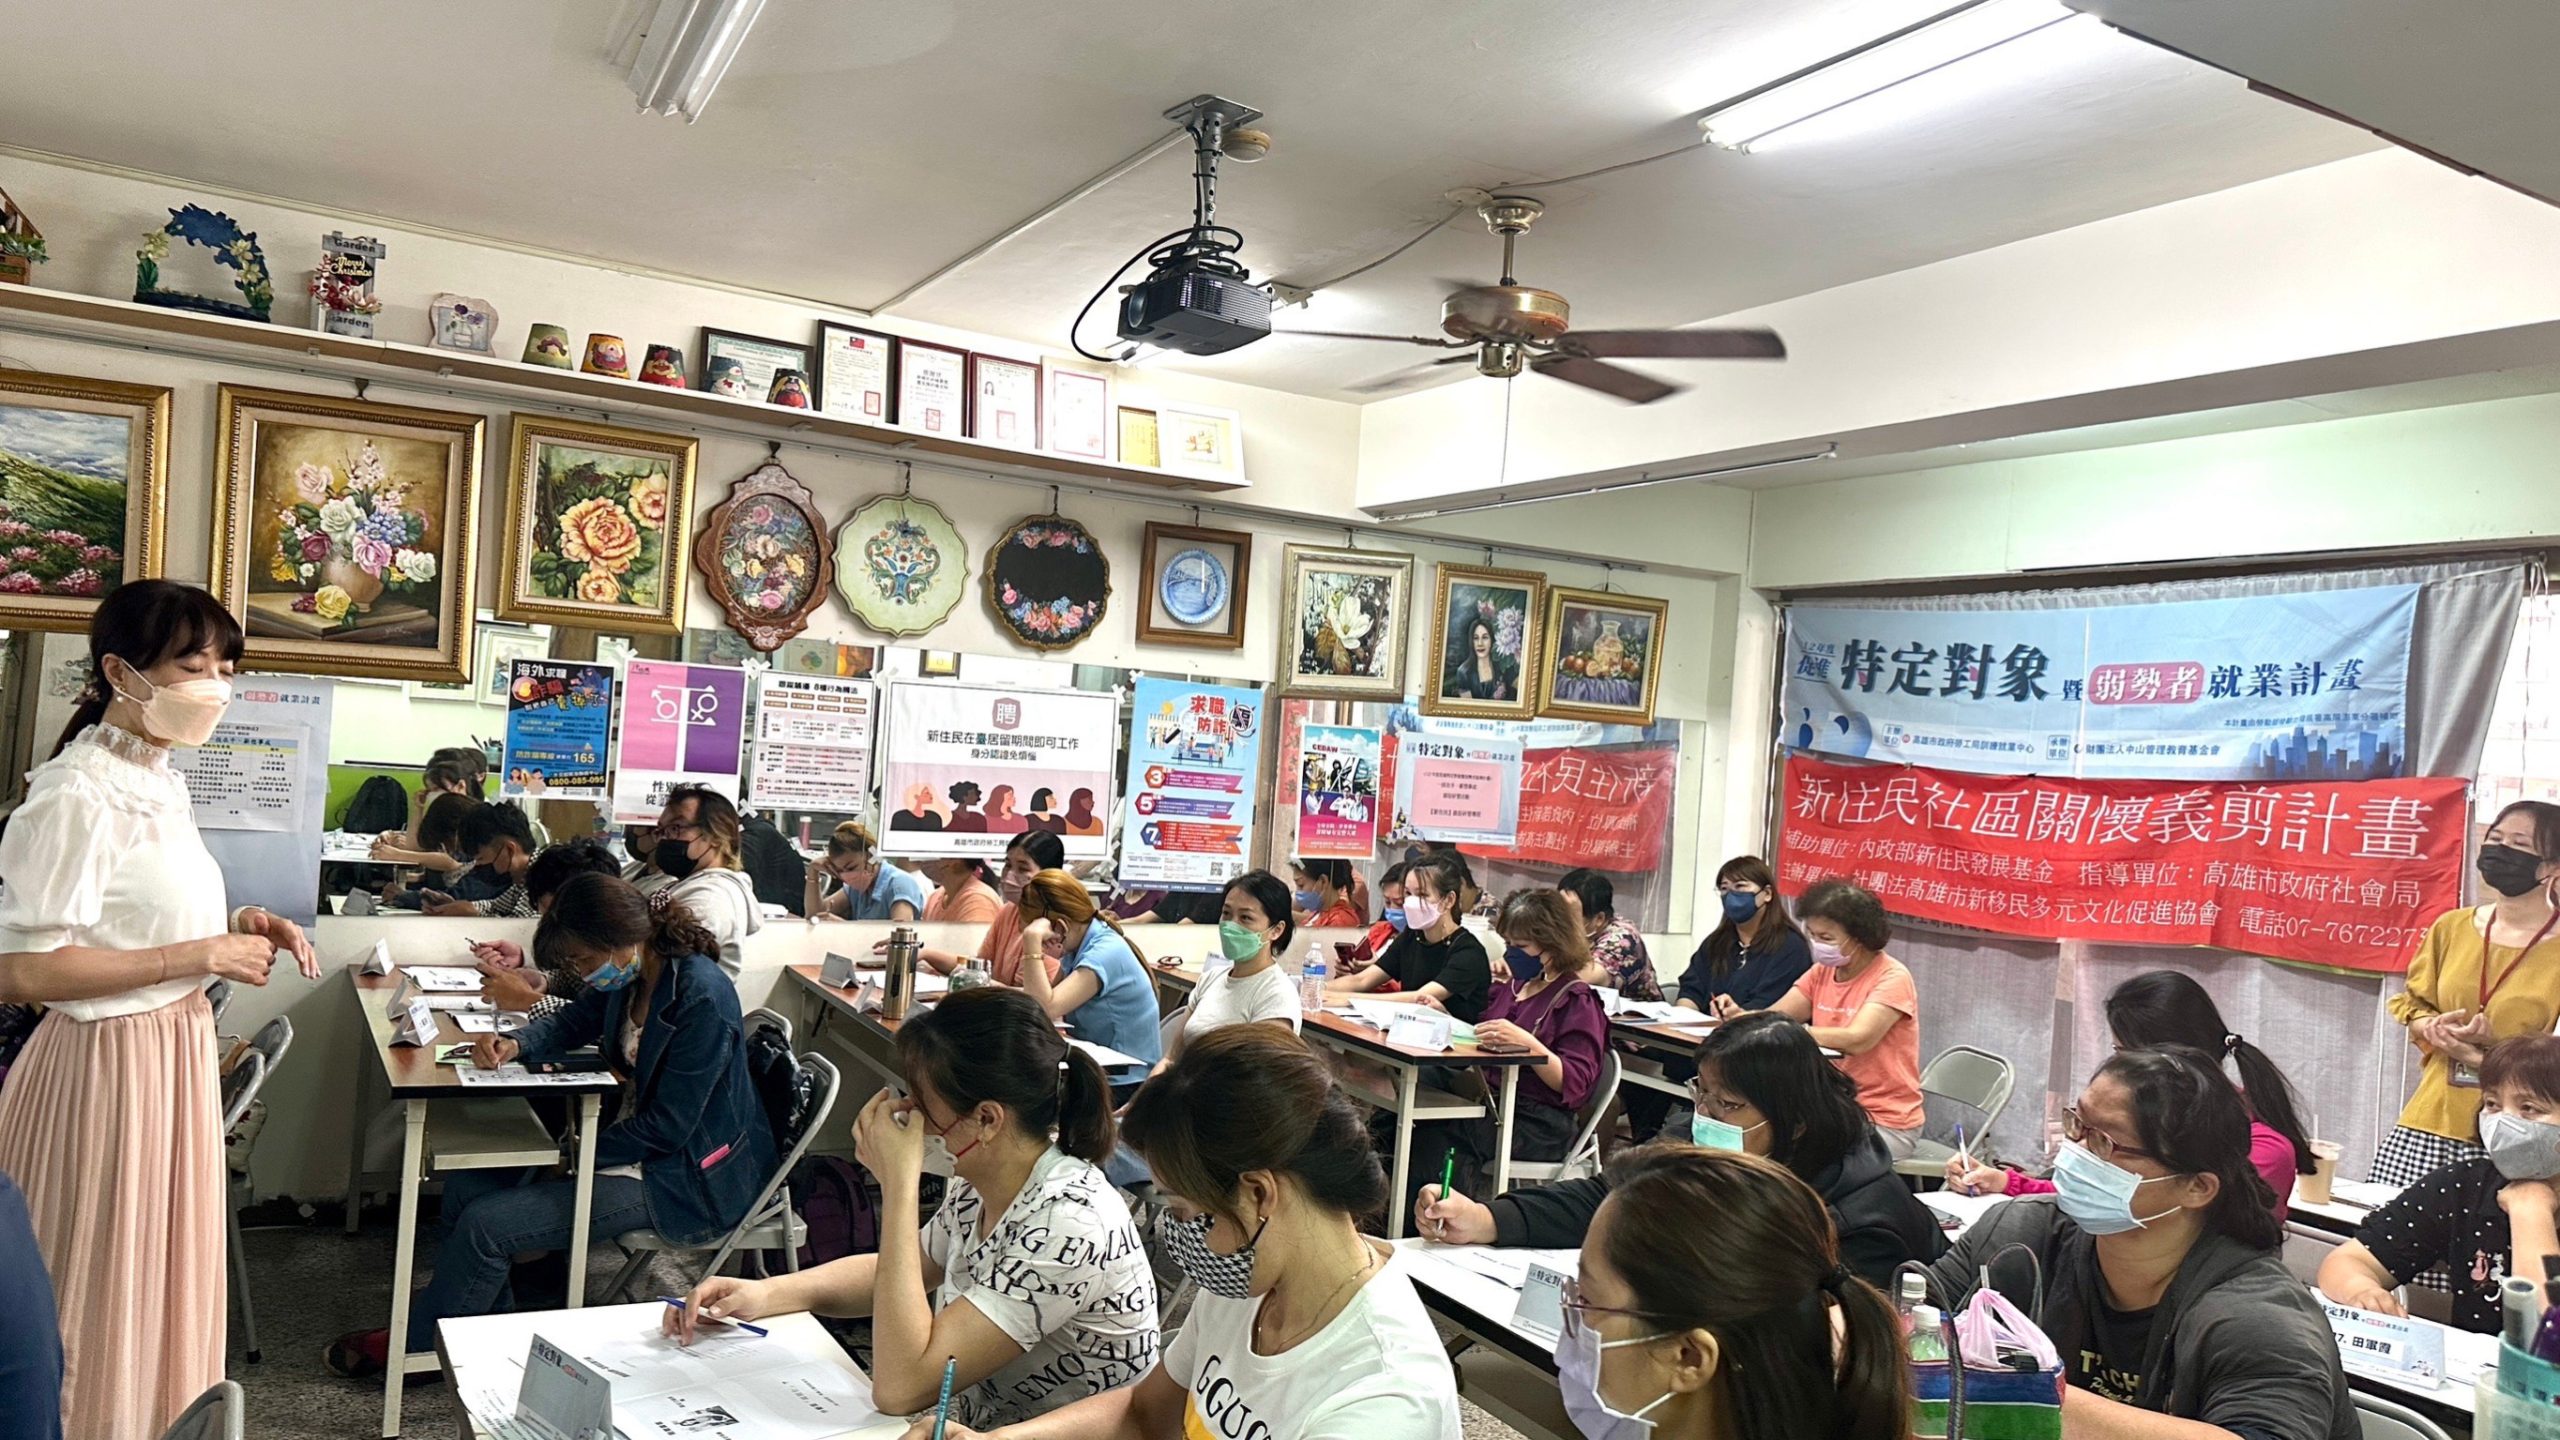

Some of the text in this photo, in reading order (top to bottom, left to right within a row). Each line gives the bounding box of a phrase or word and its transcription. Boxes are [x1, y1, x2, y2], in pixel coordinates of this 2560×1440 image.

[334, 239, 376, 252] Garden
[1797, 655, 1832, 679] 促進
[1841, 639, 2365, 701] 特定對象 暨 弱勢者 就業計畫
[996, 702, 1016, 725] 聘
[1190, 695, 1225, 715] 求職
[1197, 717, 1227, 735] 防詐
[927, 729, 1079, 750] 新住民在臺居留期間即可工作
[1912, 734, 2034, 753] 高雄市政府勞工局訓練就業中心
[573, 752, 596, 763] 165
[970, 748, 1037, 761] 身分認證免煩惱
[1418, 742, 1465, 759] 特定對象
[2086, 743, 2221, 756] 財團法人中山管理教育基金會
[1149, 769, 1164, 782] 3
[1140, 796, 1153, 811] 5
[1791, 774, 2434, 861] 新住民社區關懷義剪計畫
[1145, 827, 1159, 842] 7
[1785, 827, 2421, 909] 補助單位：內政部新住民發展基金 指導單位：高雄市政府社會局
